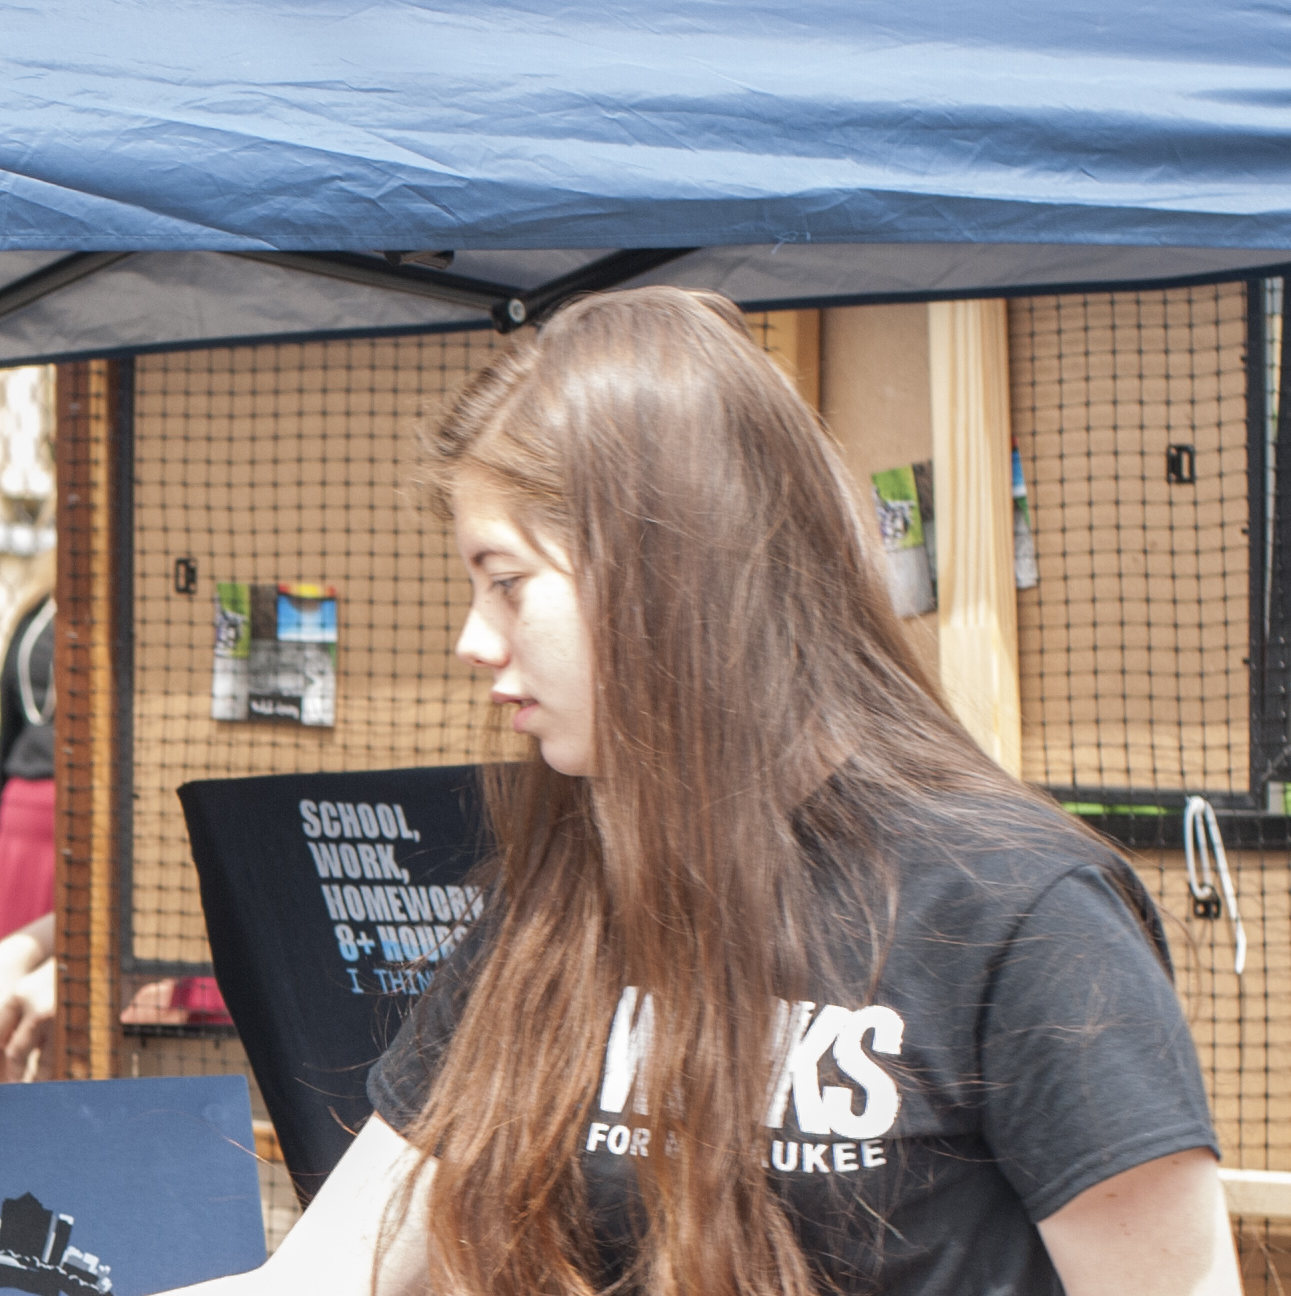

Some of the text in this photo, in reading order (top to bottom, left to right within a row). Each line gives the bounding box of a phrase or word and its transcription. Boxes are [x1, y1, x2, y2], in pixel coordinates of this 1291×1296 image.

[299, 799, 421, 843] SCHOOL,
[307, 841, 410, 885] WORK,
[334, 923, 376, 962] 8+
[345, 967, 365, 994] I
[586, 1122, 651, 1157] FOR
